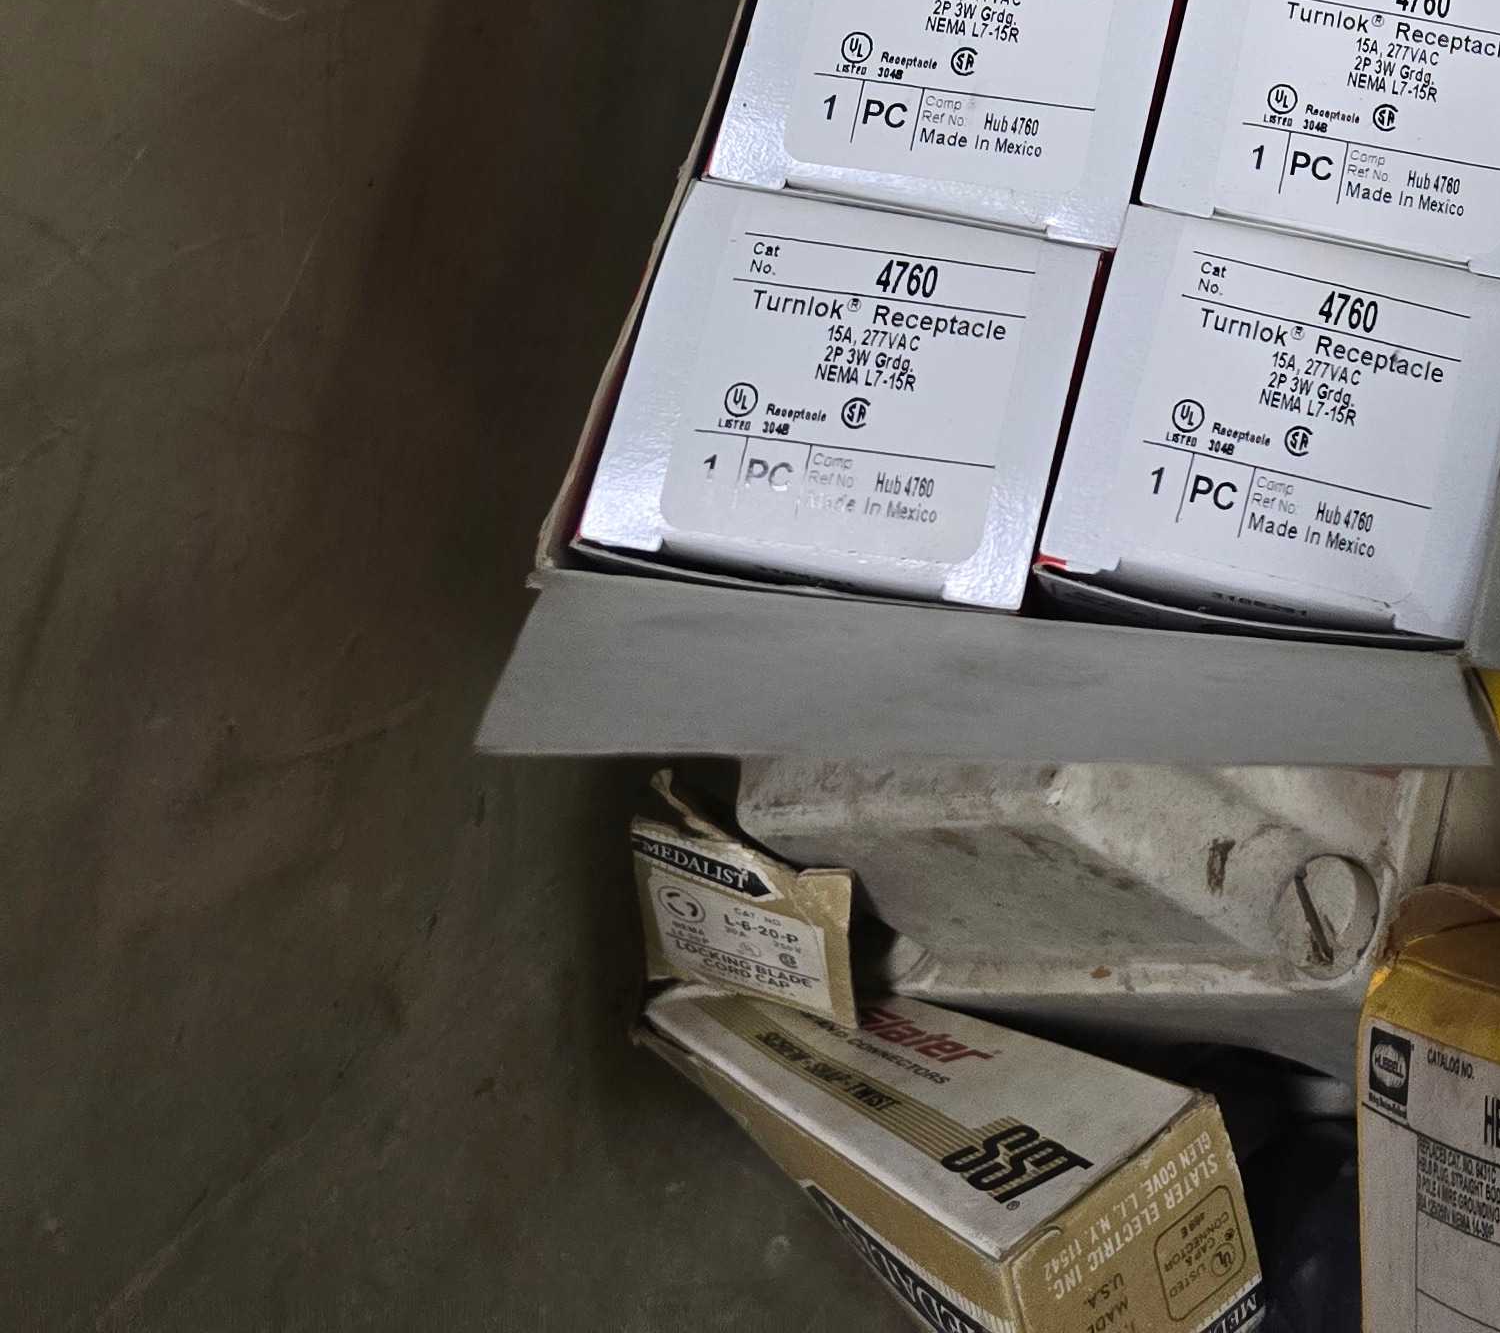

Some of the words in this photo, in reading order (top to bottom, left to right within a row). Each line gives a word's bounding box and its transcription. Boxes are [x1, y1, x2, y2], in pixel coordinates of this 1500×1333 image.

[1353, 55, 1372, 72] 2P
[1374, 58, 1396, 77] 3W
[1399, 64, 1434, 88] Grdg.
[1386, 42, 1439, 66] 277VAC
[1346, 71, 1386, 93] NEMA
[1391, 79, 1437, 103] L7-15R
[1252, 144, 1264, 170] 1
[1289, 150, 1334, 181] PC
[1345, 180, 1392, 204] Made
[1398, 190, 1414, 207] In
[1417, 193, 1464, 217] Mexico
[1406, 169, 1431, 190] Hub
[1433, 174, 1460, 195] 4760
[875, 259, 938, 298] 4760
[868, 304, 1006, 340] Receptacle
[1318, 290, 1378, 333] 4760
[1311, 334, 1444, 383] Receptacle
[643, 839, 745, 889] MEDALIST
[675, 939, 752, 971] LOCKING
[755, 964, 813, 989] BLADE
[703, 958, 751, 978] CORD
[755, 973, 790, 989] CAP
[849, 1038, 951, 1084] CONNECTORS
[1427, 1049, 1459, 1074] CATALOG
[1459, 1061, 1474, 1080] NO.
[1179, 1132, 1212, 1169] GLEN
[1165, 1153, 1219, 1210] SLATER
[1088, 1210, 1161, 1272] ELECTRIC
